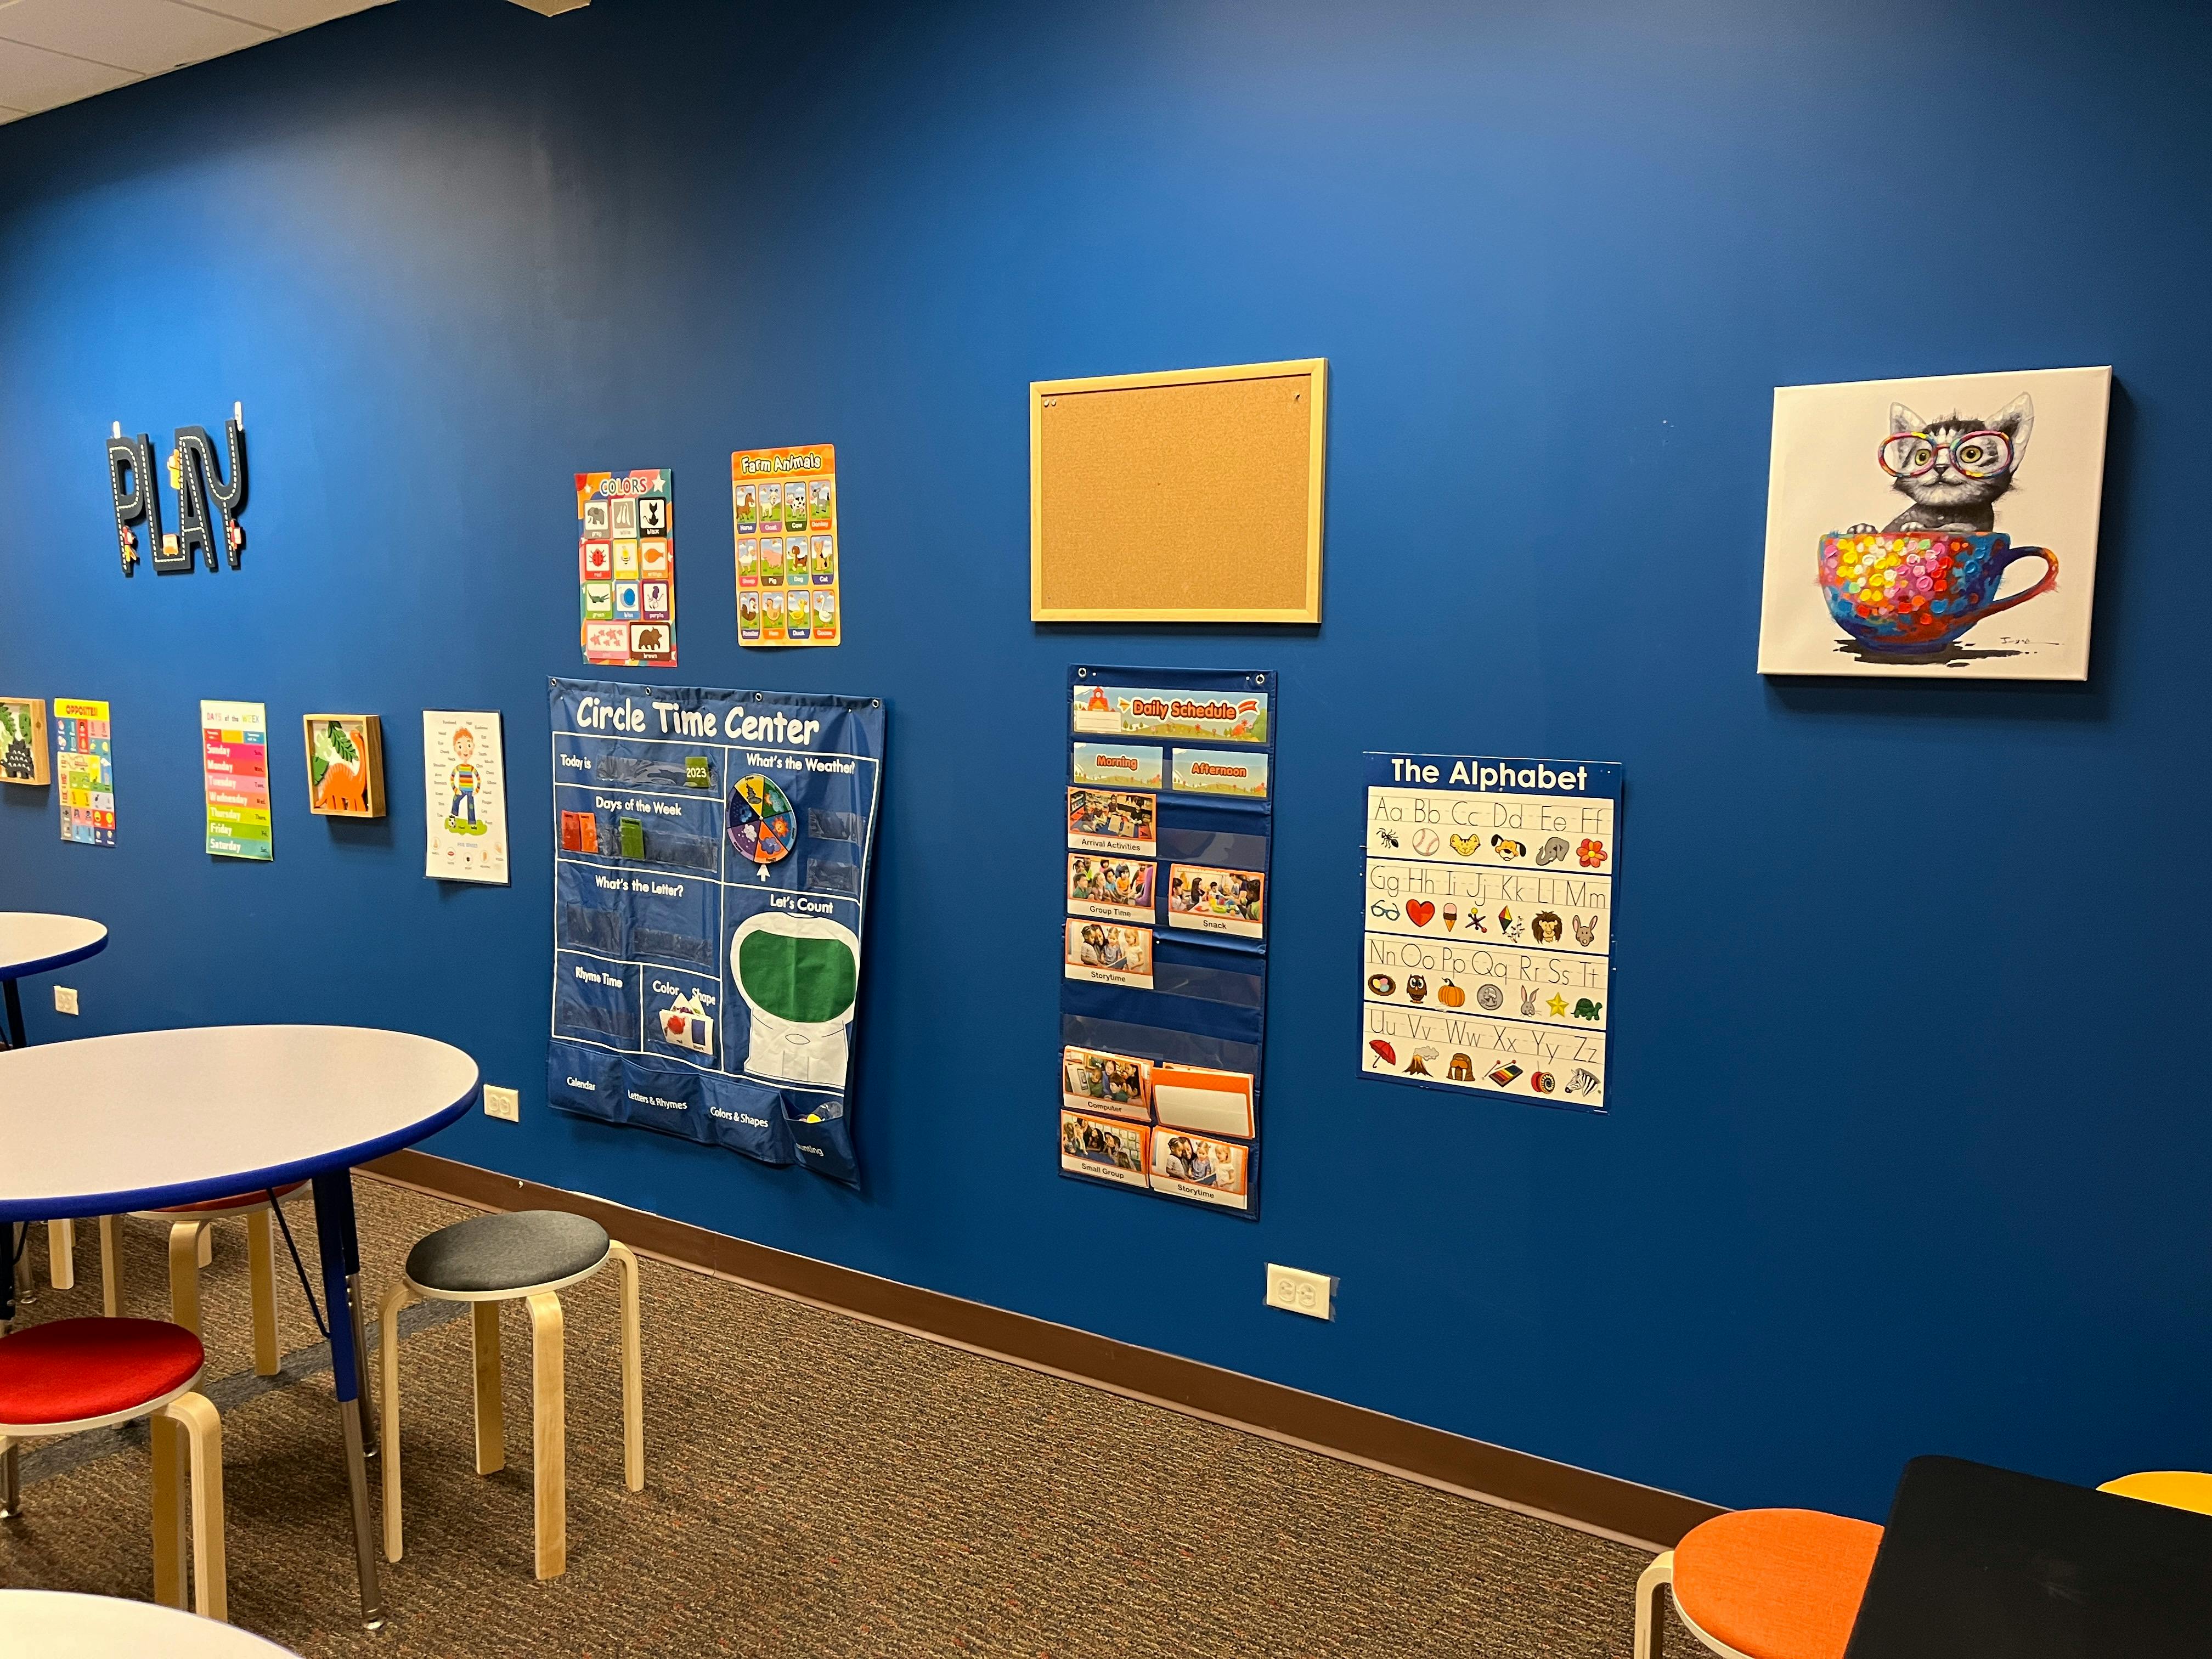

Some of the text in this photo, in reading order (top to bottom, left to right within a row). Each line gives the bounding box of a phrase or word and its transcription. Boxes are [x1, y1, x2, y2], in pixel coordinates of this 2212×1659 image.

[742, 453, 821, 473] Farm Animals
[601, 478, 647, 495] COLORS
[106, 419, 241, 574] PLAY
[1132, 699, 1237, 720] Daily Schedule
[576, 697, 820, 746] Circle Time Center
[207, 743, 230, 757] Sunday
[207, 759, 233, 773] Monday
[560, 754, 591, 769] Today is
[747, 753, 855, 775] What's the Weather?
[1097, 755, 1138, 770] Morning
[686, 767, 707, 778] 2023
[1192, 763, 1246, 777] Afternoon
[1391, 758, 1588, 791] The Alphabet
[208, 775, 236, 789] Tuesday
[209, 791, 247, 806] Wednesday
[596, 796, 682, 816] Days of the Week
[210, 806, 241, 821] Thursday
[1375, 797, 1602, 834] Aa Bb Cc Dd Ee Ff
[211, 822, 232, 837] Friday
[210, 838, 241, 854] Saturday
[1082, 839, 1141, 851] Arrival Activities
[595, 876, 684, 898] What's the Letter?
[1370, 865, 1606, 909] Gg Hh Ii Jj Kk Ll Mm
[770, 894, 834, 913] Let's Count
[1090, 905, 1131, 917] Group Time
[1203, 920, 1227, 930] Snack
[1371, 939, 1597, 988] Nn Oo Pp Qq Rr Ss Tt
[575, 966, 623, 989] Rhyme Time
[1091, 971, 1126, 983] Storytime
[652, 980, 716, 1006] Color Shape
[1371, 1010, 1598, 1064] Uu Vv Ww Xx Yy Zz
[567, 1076, 596, 1091] Calendar
[628, 1090, 688, 1111] Letters & Rhymes
[1087, 1101, 1122, 1113] Computer
[710, 1106, 769, 1128] Colors & Shapes
[1082, 1163, 1124, 1179] Small Group
[1177, 1184, 1215, 1199] Storytime
